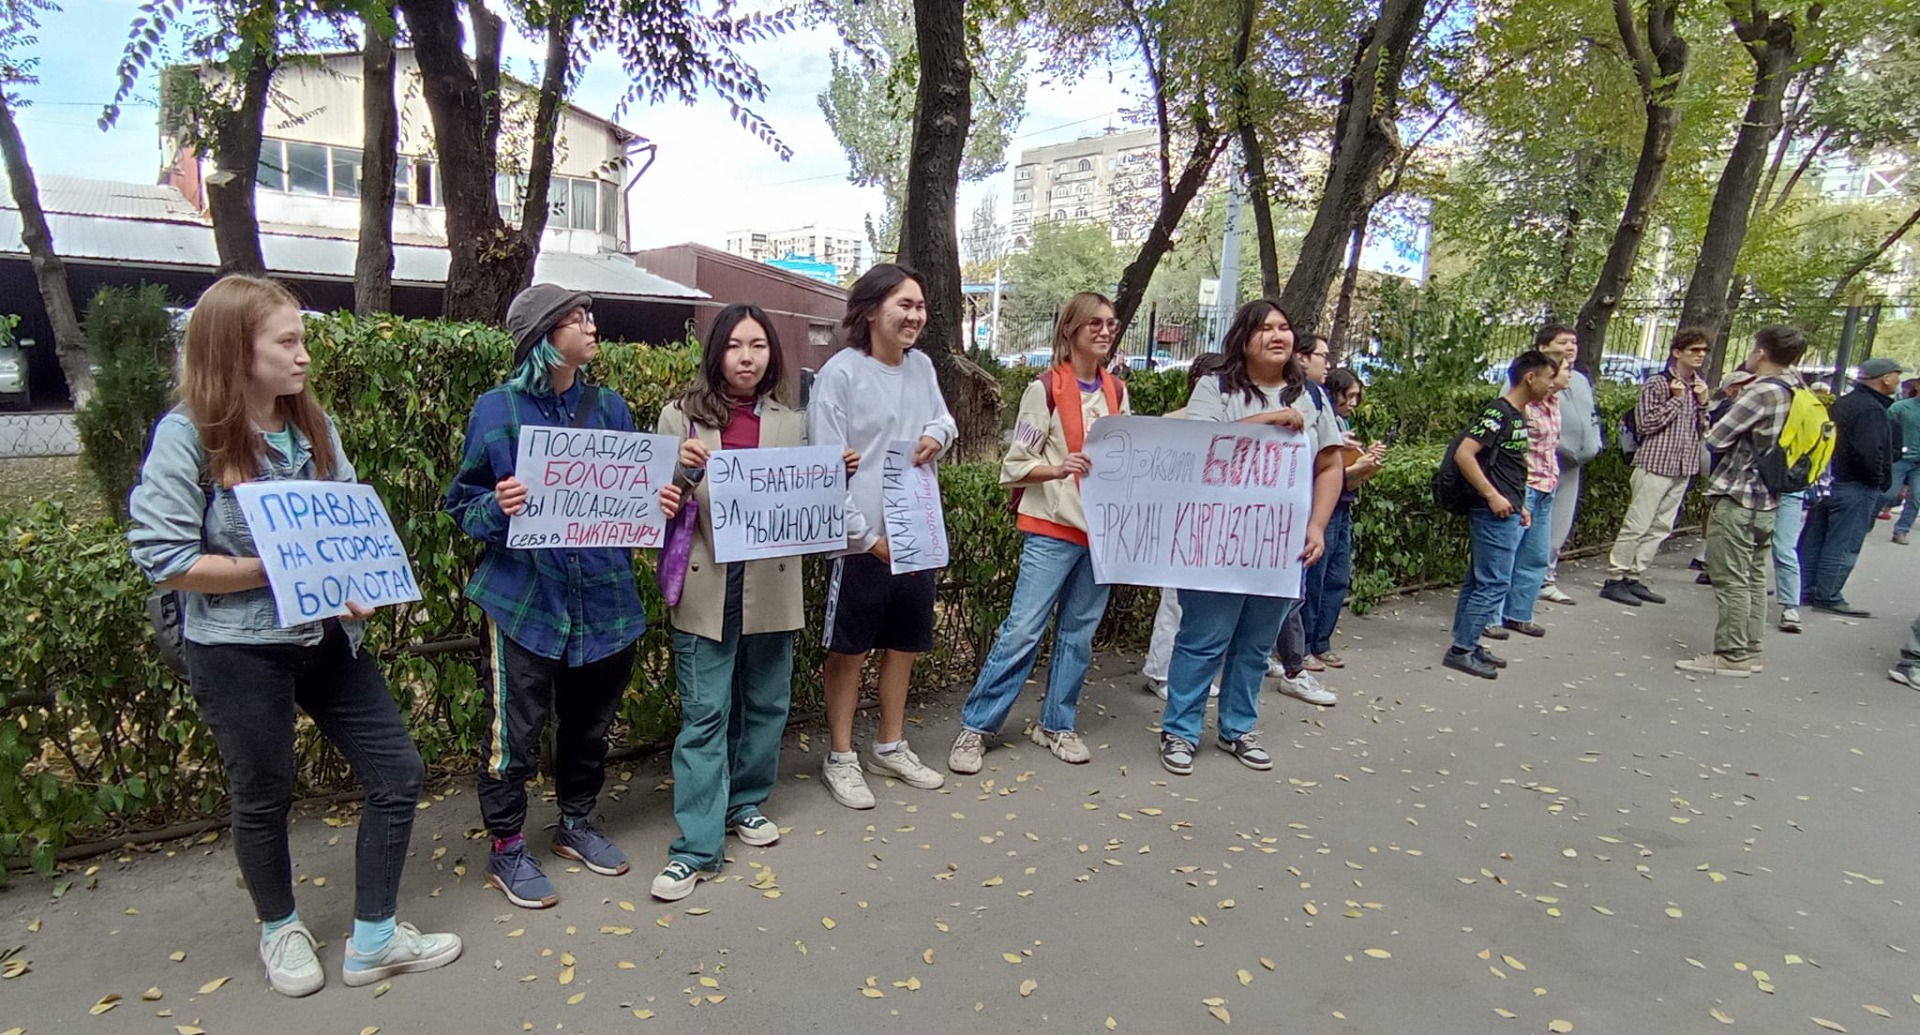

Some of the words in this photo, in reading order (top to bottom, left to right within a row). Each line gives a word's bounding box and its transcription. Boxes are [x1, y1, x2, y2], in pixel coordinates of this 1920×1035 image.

[529, 429, 653, 463] ПОСАДИВ
[1201, 434, 1306, 489] БОЛОТ
[712, 456, 744, 483] ЭЛ
[750, 464, 840, 493] БААТЫРЫ
[260, 492, 387, 532] ПРАВДА
[714, 499, 741, 530] ЭЛ
[745, 504, 845, 544] КЫЙНООЧУ
[277, 541, 313, 570] НА
[316, 535, 401, 563] СТОРОНЕ
[565, 520, 660, 546] ДИКТАТУРУ
[1095, 503, 1163, 565] ЭРКИН
[1170, 502, 1295, 570] КЫРГЫЗСТАН
[295, 565, 415, 617] БОЛОТА!
